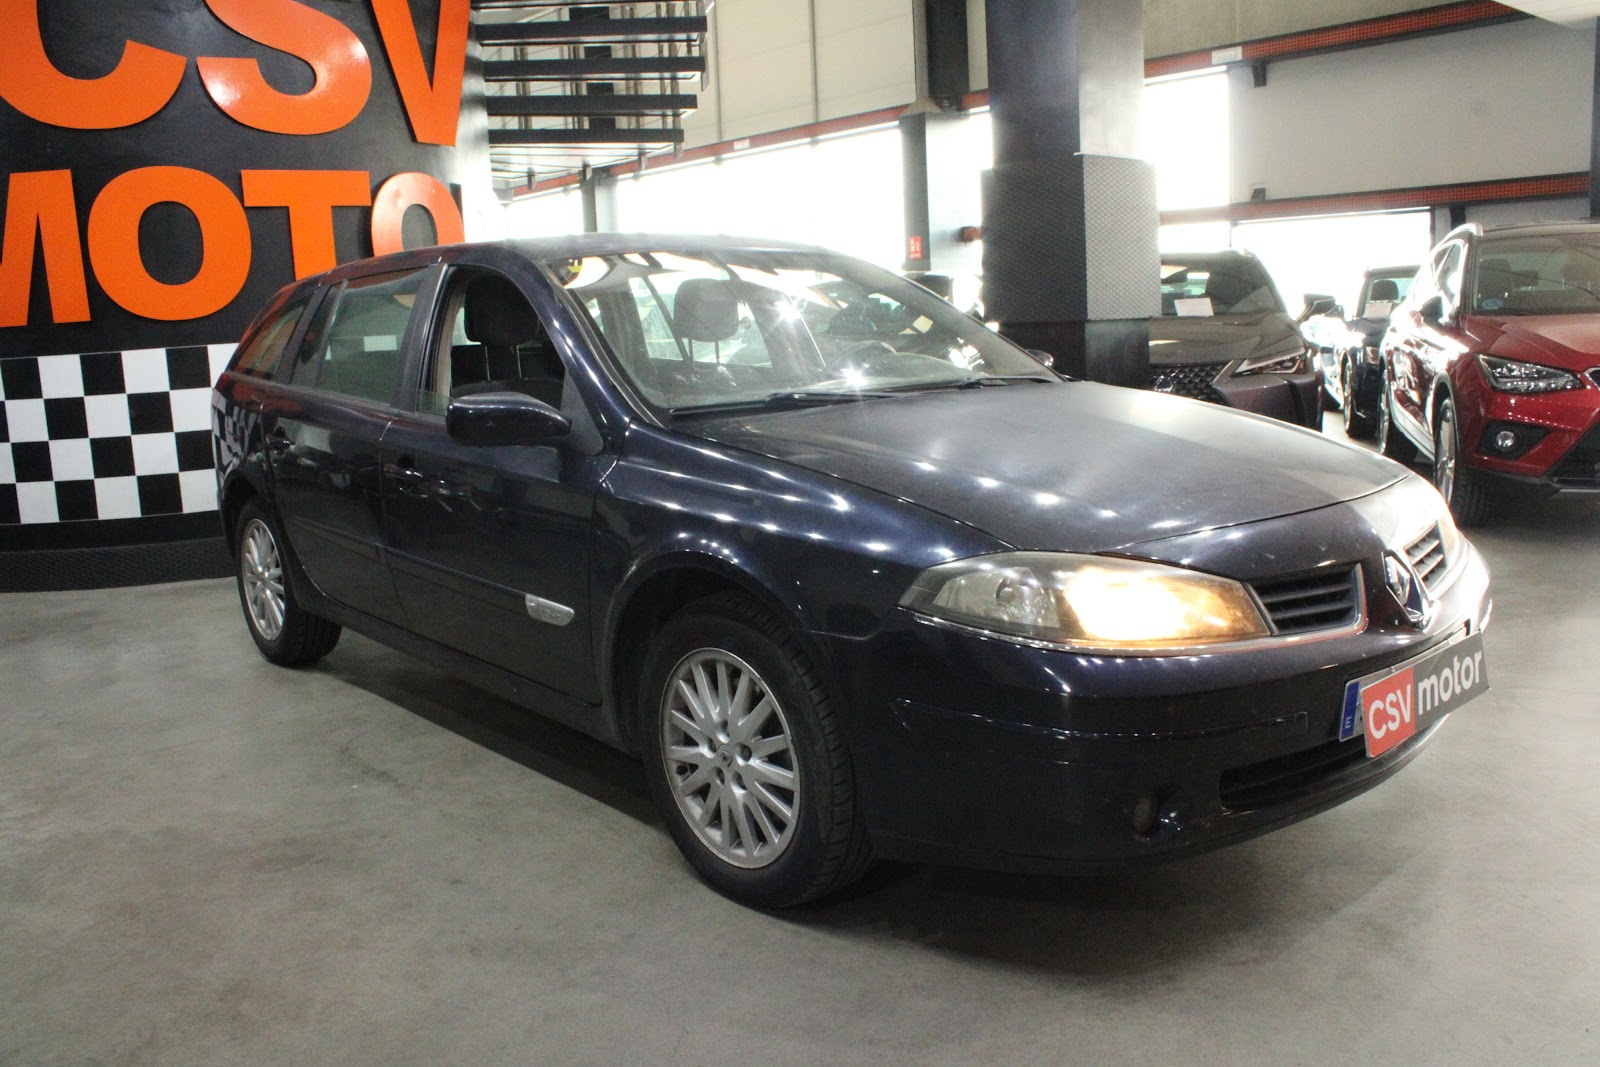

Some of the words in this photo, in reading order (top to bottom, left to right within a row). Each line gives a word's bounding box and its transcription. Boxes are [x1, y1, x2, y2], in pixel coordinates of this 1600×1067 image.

[0, 0, 471, 147] CSV
[1344, 716, 1352, 729] E
[1368, 684, 1412, 739] CSV
[1418, 651, 1482, 715] motor
